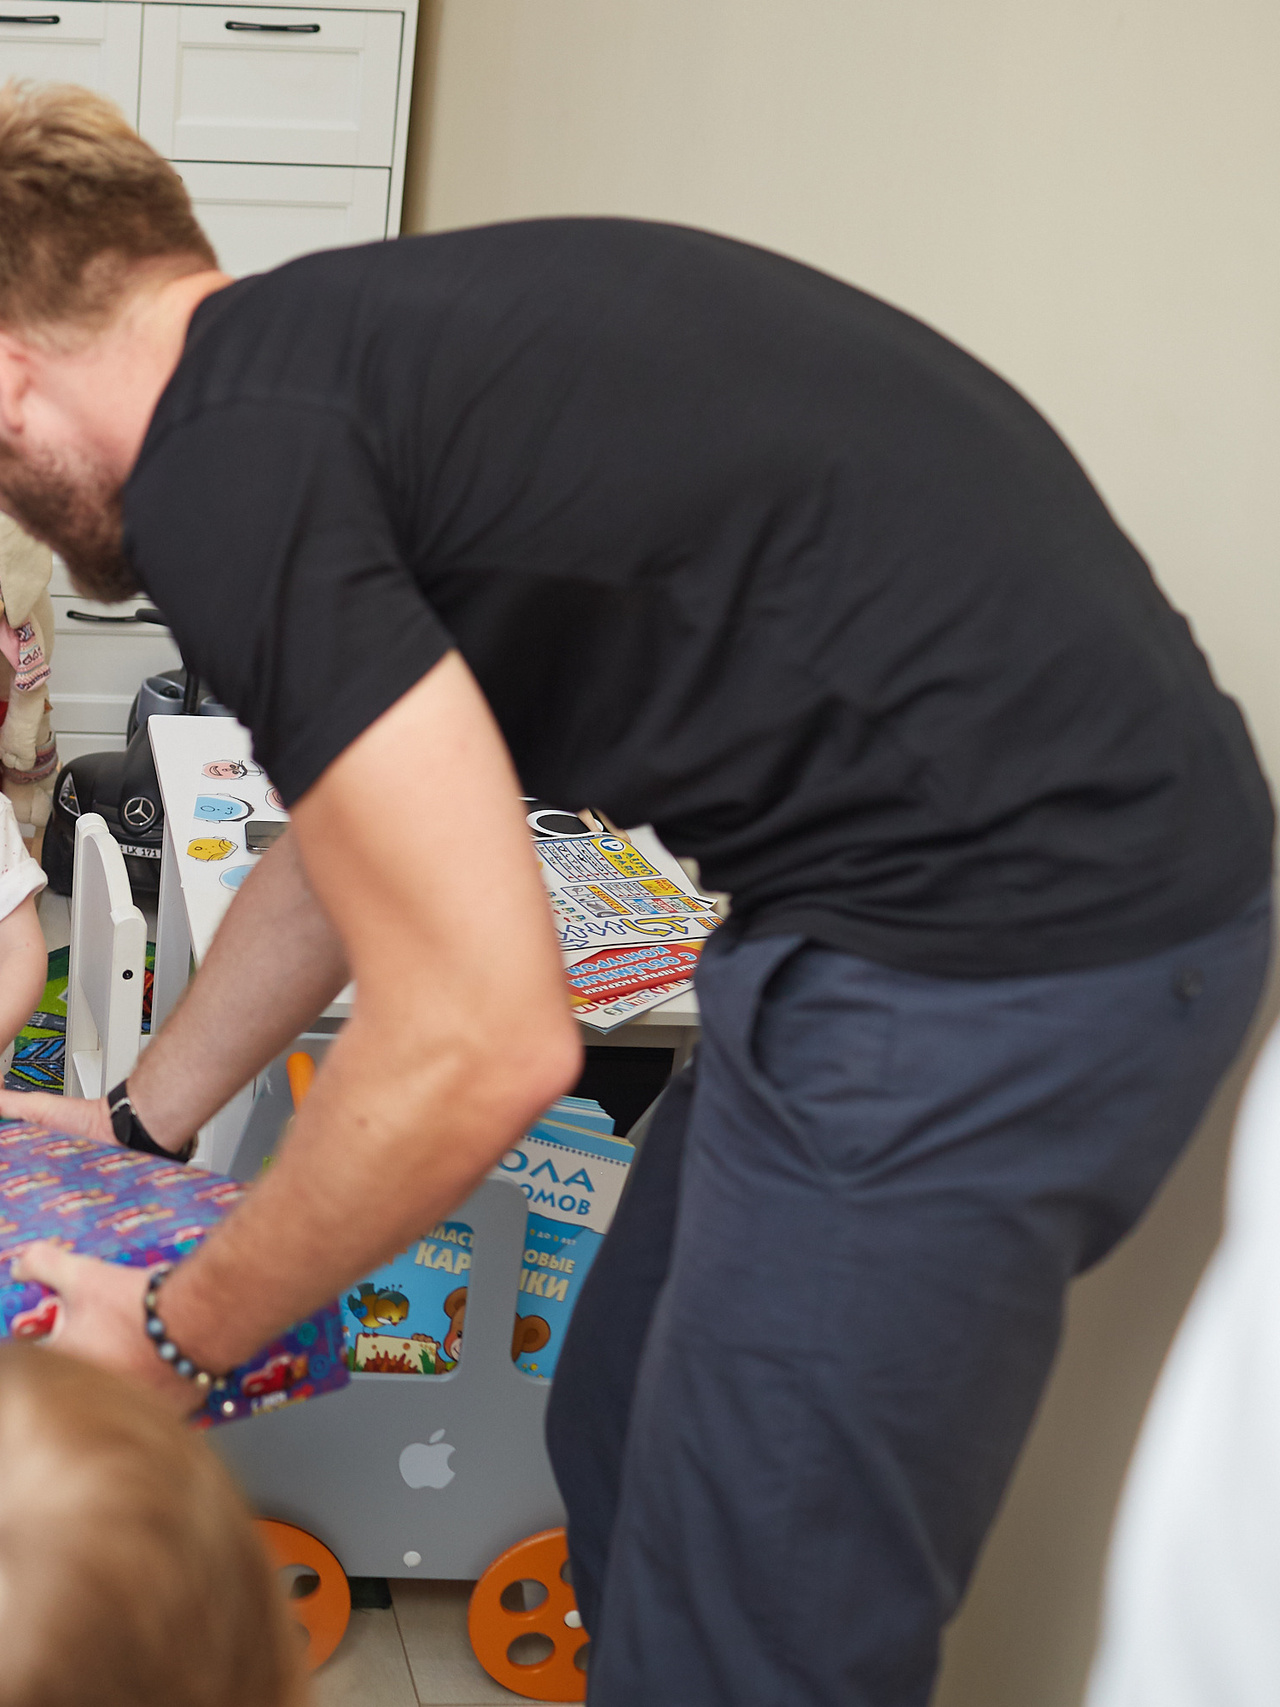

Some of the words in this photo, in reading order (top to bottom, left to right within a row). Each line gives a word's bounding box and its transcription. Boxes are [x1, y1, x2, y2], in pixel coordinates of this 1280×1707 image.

[140, 847, 158, 857] 171
[609, 854, 641, 877] PARK
[622, 852, 653, 876] AUTO
[593, 890, 622, 910] SERVICE
[566, 946, 672, 977] КОНТУРОМ
[680, 952, 697, 961] С
[567, 956, 681, 988] ОБЪЁМНЫМ
[639, 968, 676, 982] ПЕРВЫЕ
[582, 978, 639, 995] РАСКРАСКИ
[496, 1148, 596, 1193] ОЛА
[520, 1183, 592, 1215] ОМОВ
[414, 1242, 472, 1275] КАР
